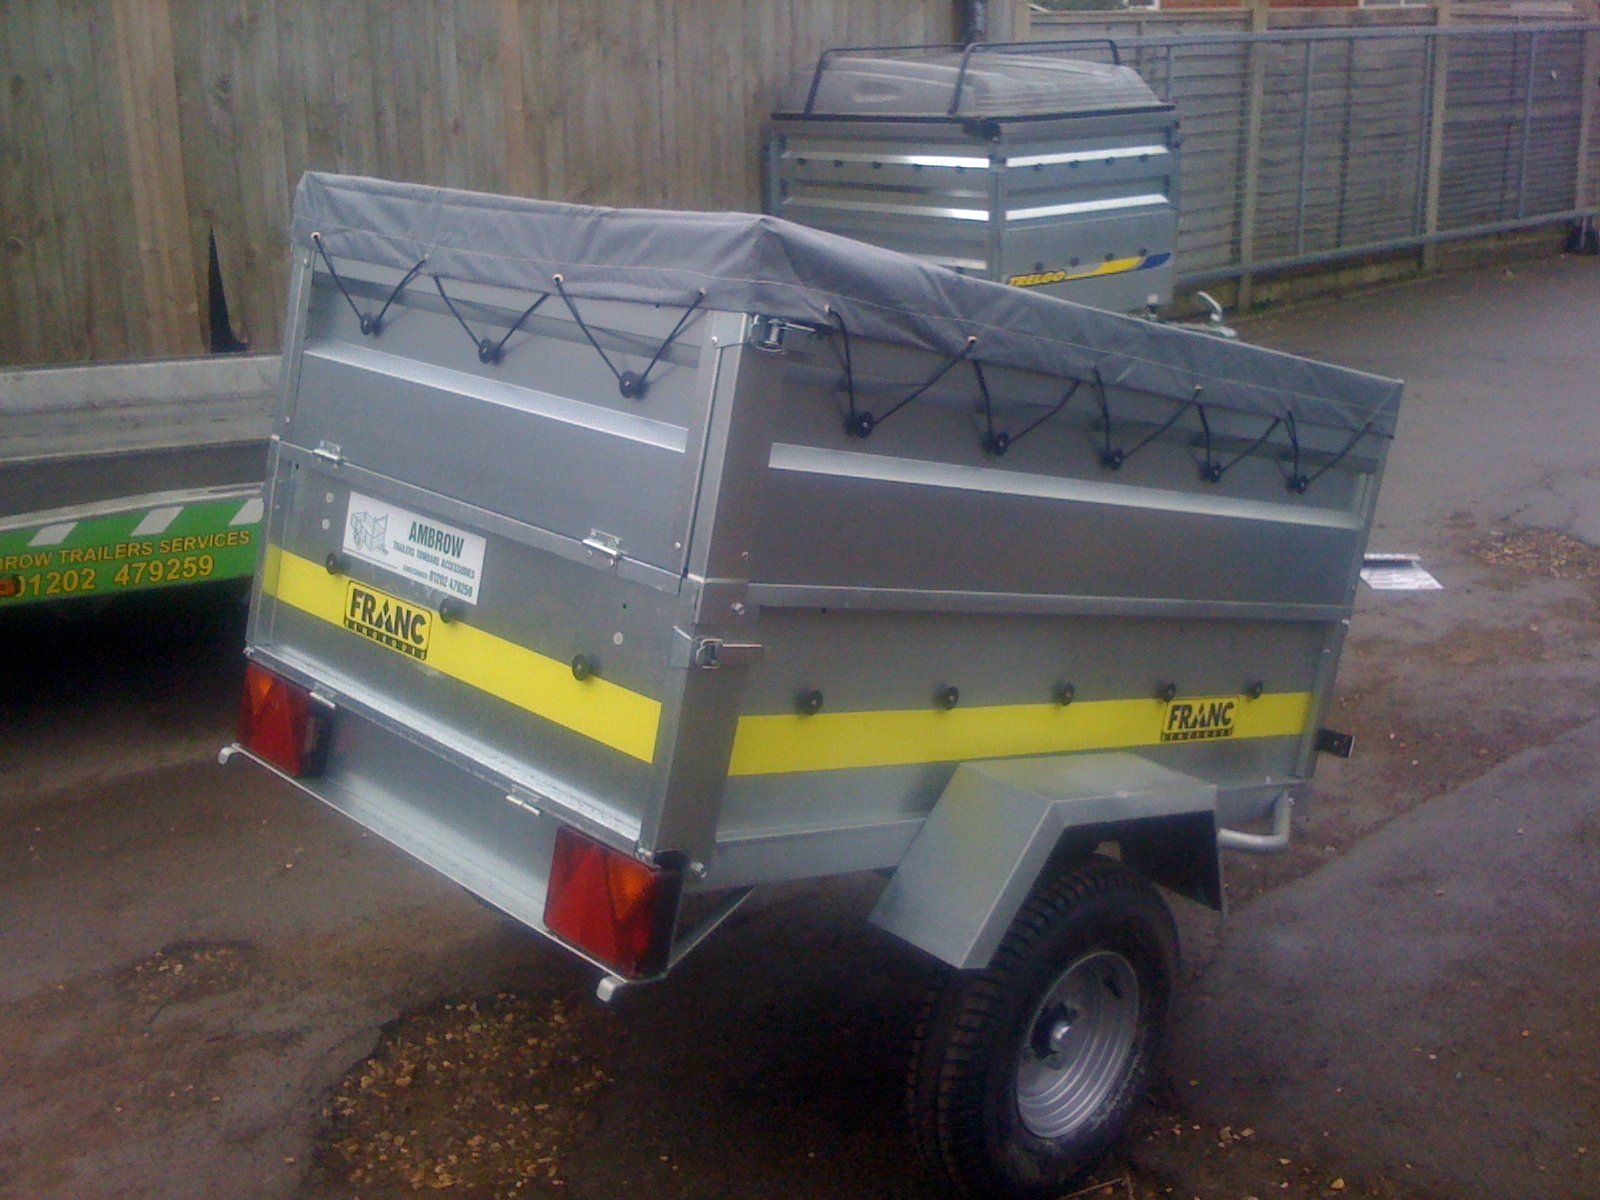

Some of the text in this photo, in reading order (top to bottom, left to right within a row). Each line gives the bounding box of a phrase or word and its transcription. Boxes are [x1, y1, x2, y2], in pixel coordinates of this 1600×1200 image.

[59, 540, 153, 565] TRAILERS
[159, 531, 250, 554] SERVICES
[393, 541, 415, 558] TRAILERS
[409, 522, 465, 558] AMBROW
[114, 554, 214, 586] 479259
[428, 569, 448, 588] 01202
[350, 588, 426, 644] FRANC
[1167, 702, 1234, 729] FRANC
